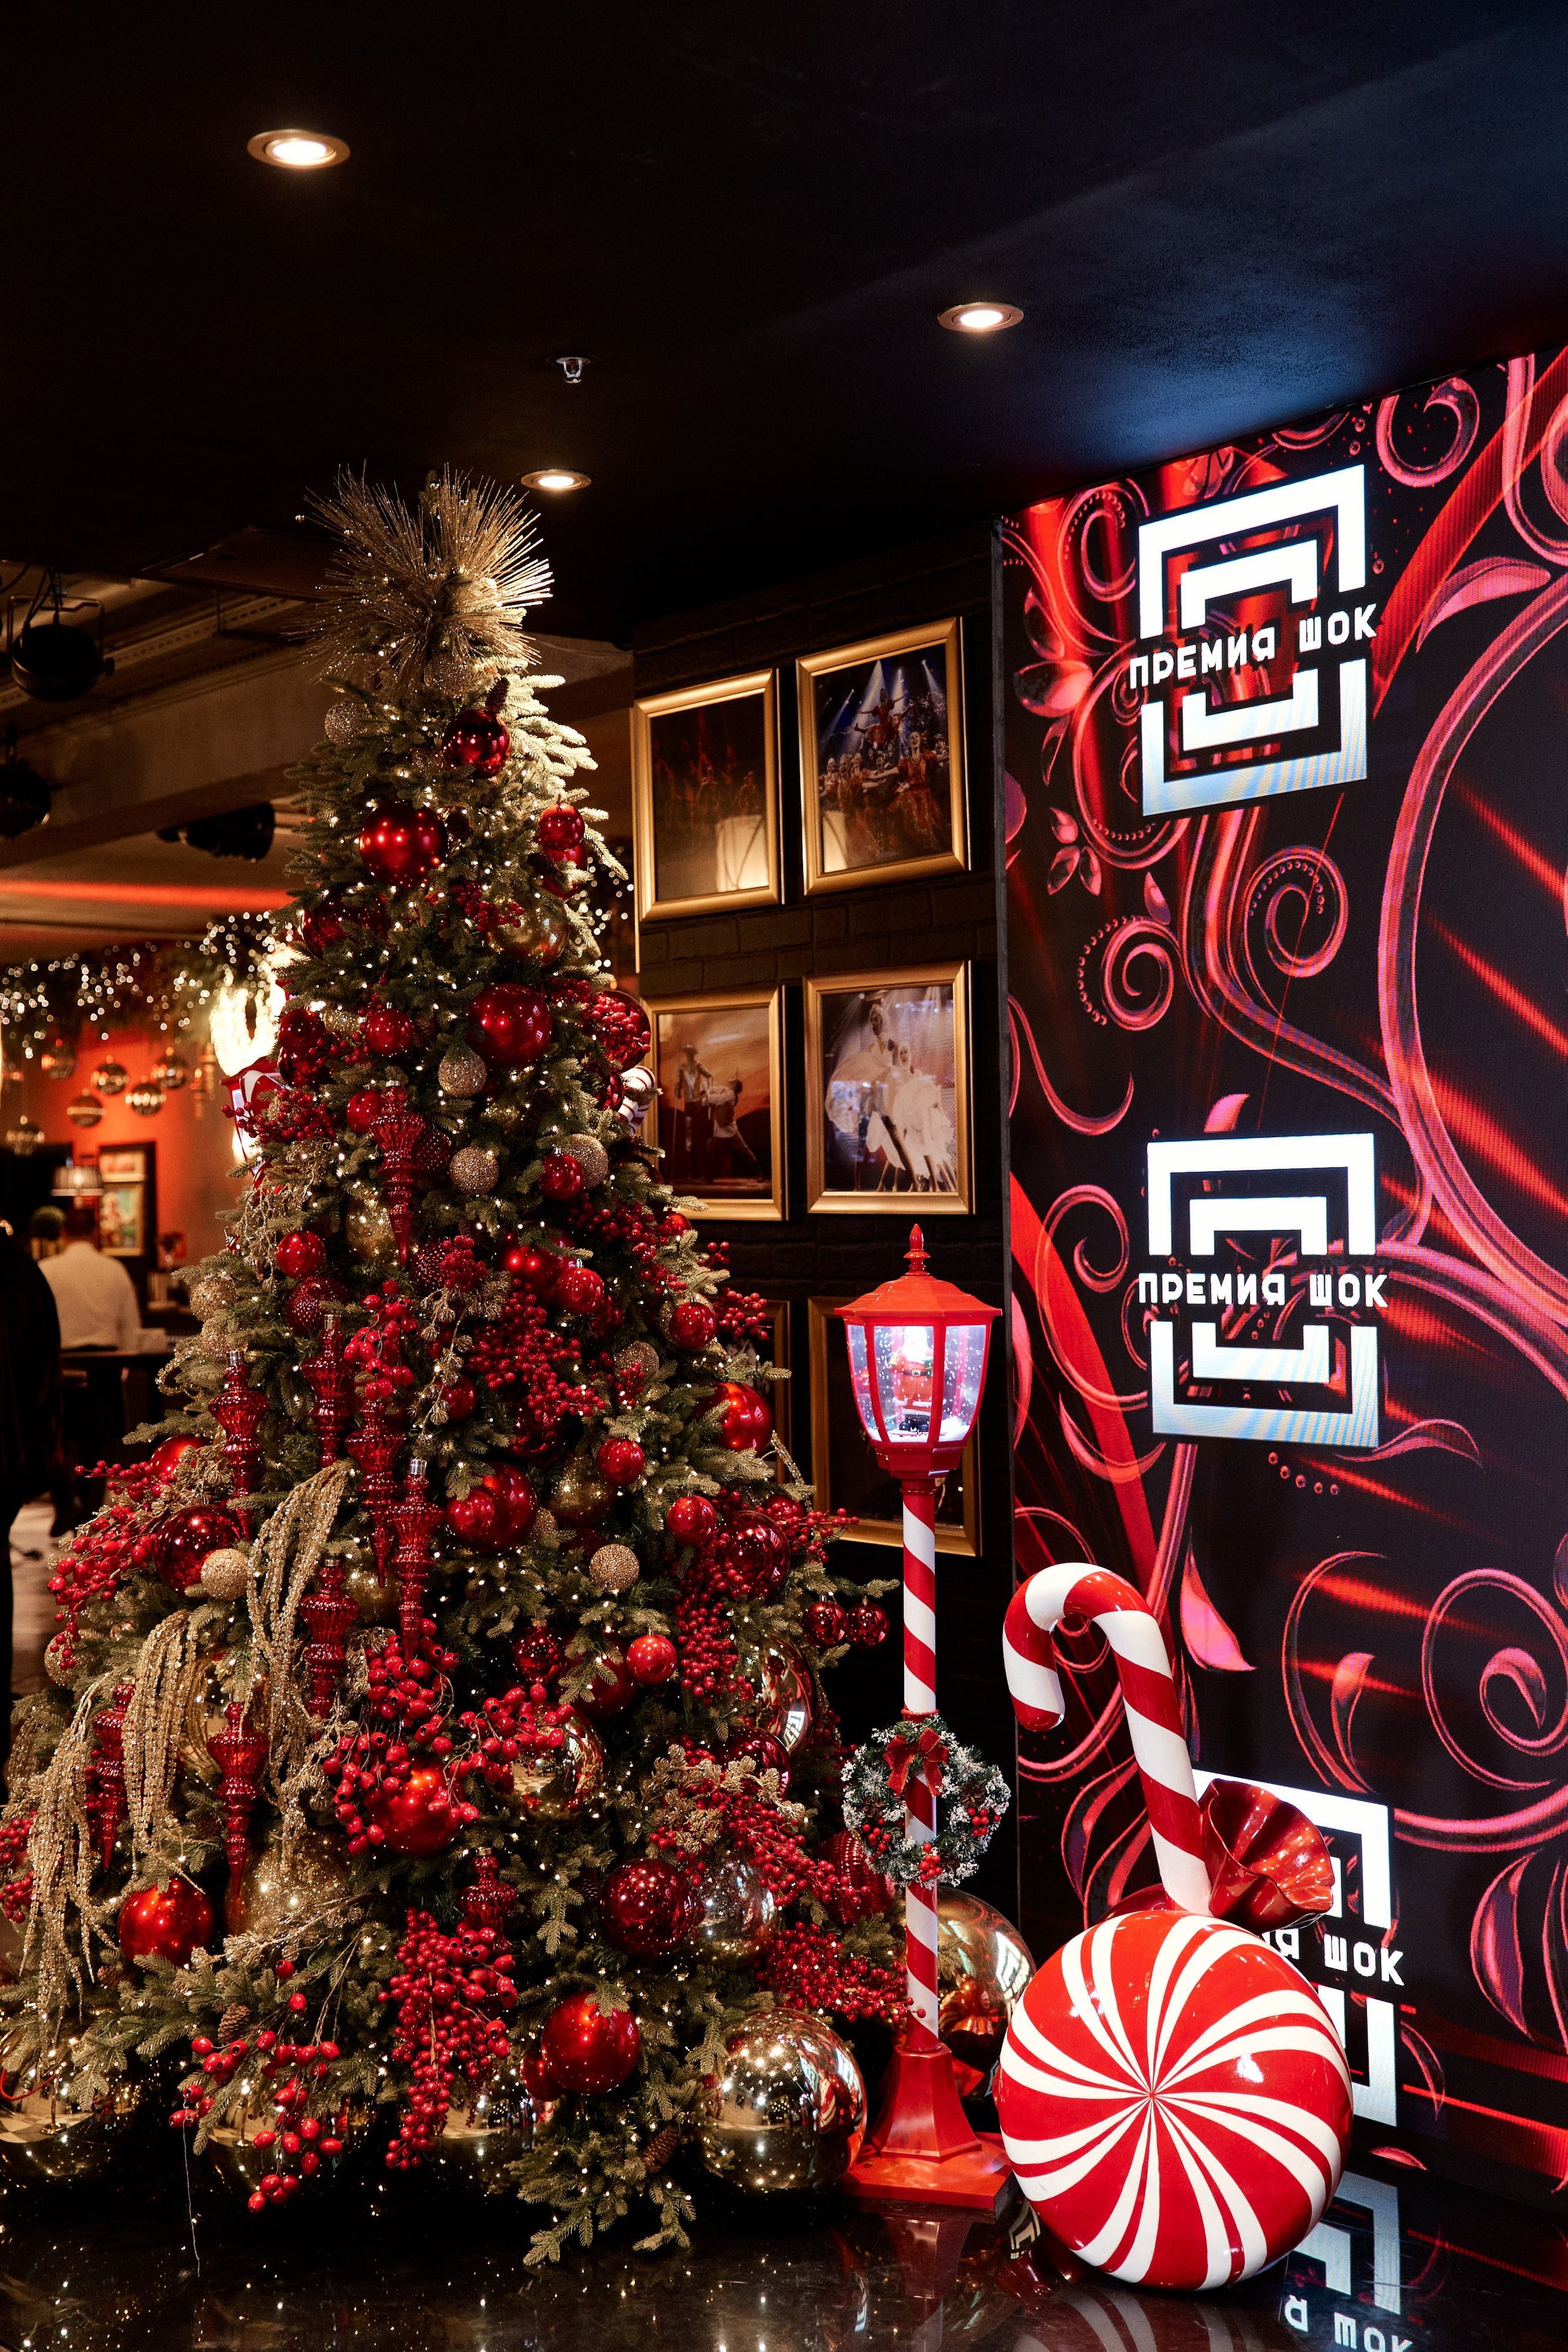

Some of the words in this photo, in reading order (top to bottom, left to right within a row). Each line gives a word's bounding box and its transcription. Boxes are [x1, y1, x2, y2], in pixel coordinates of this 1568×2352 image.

[1129, 627, 1275, 690] ПРЕМИЯ
[1298, 603, 1377, 653] ШОК
[1138, 1273, 1285, 1306] ПРЕМИЯ
[1309, 1273, 1389, 1308] ШОК
[1324, 1933, 1404, 1986] ШОК
